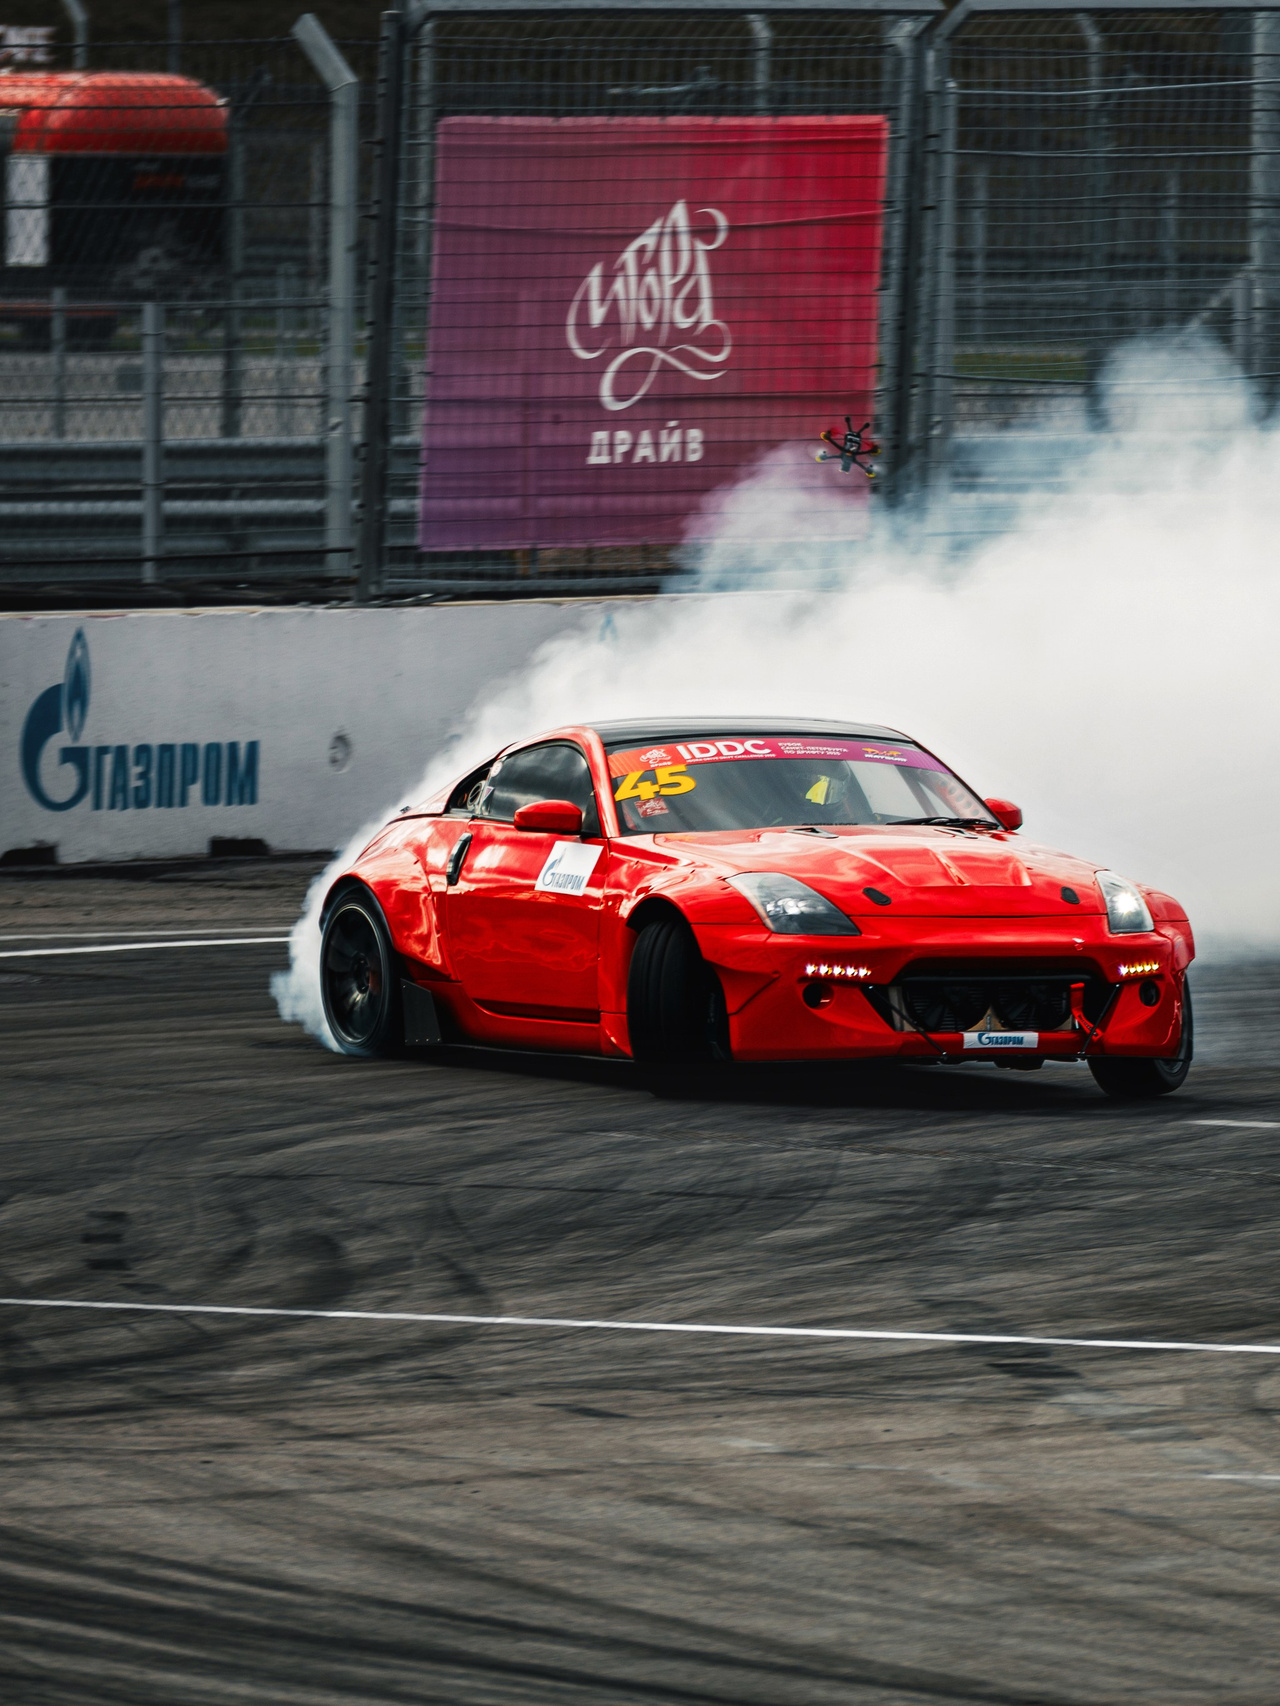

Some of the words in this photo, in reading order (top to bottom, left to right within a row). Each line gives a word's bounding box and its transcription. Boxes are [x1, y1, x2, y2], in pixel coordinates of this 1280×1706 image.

[585, 420, 705, 465] ДРАЙВ
[676, 740, 771, 760] IDDC
[91, 740, 260, 811] ГАЗПРОМ
[614, 764, 696, 802] 45
[551, 873, 585, 891] ГАЗПРОМ
[990, 1036, 1024, 1046] ГАЗПРОМ
